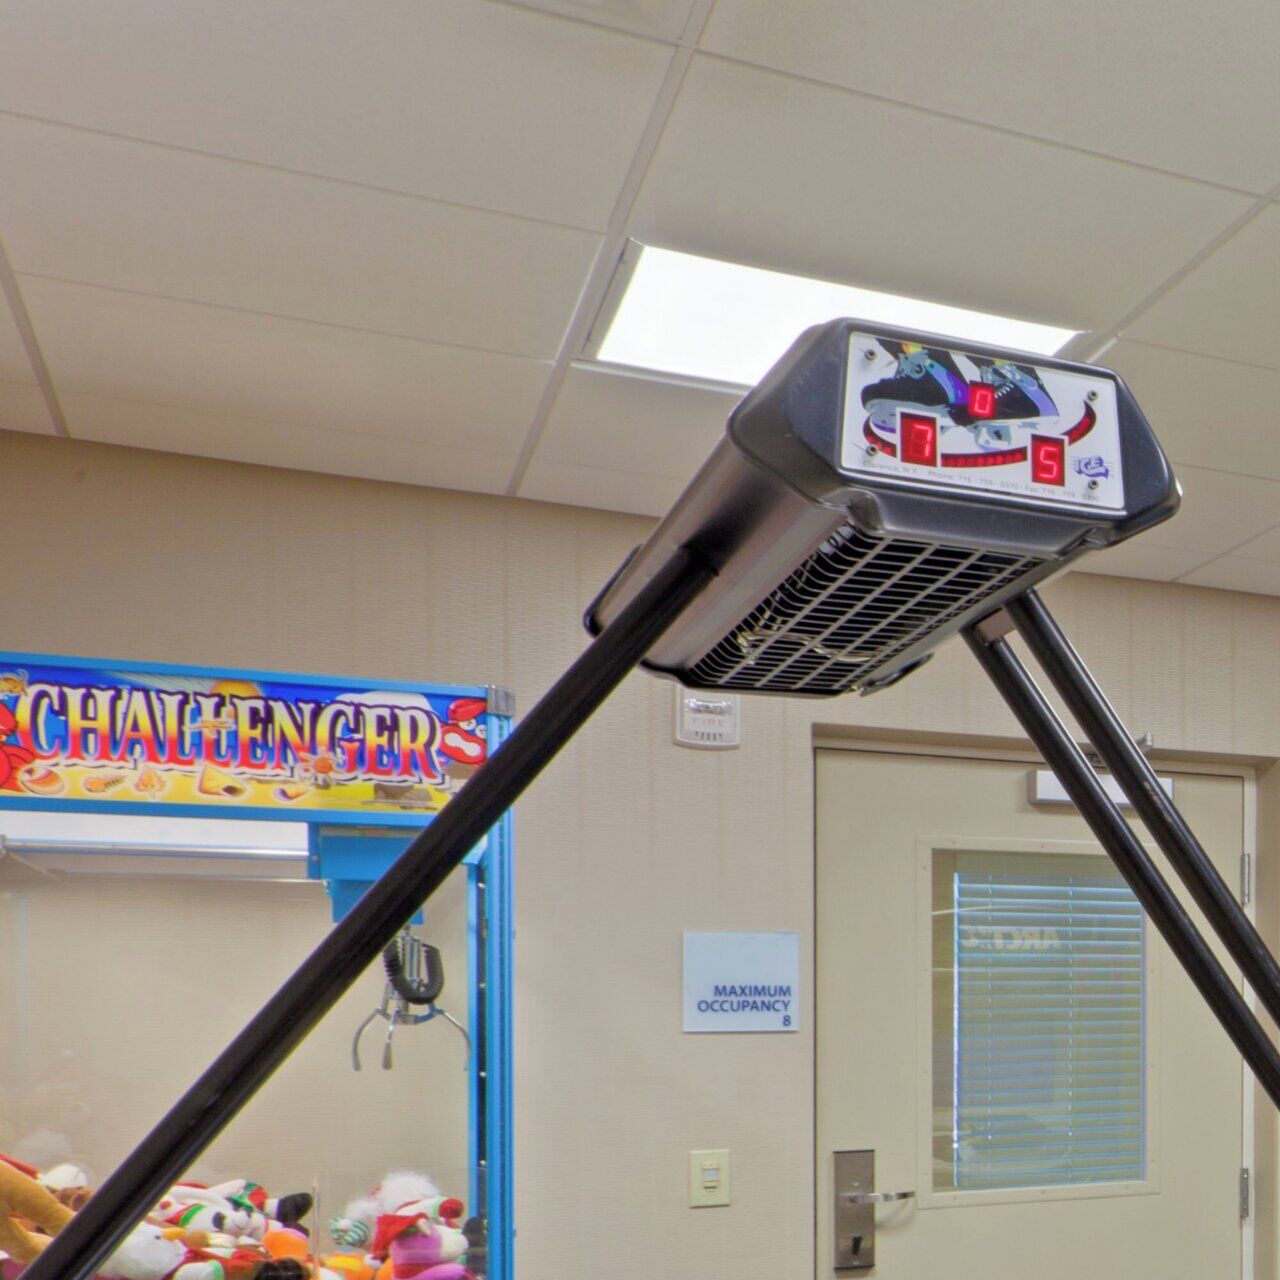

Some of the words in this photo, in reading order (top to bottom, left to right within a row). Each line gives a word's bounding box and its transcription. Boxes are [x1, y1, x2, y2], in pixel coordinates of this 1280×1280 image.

[974, 390, 992, 414] 0
[915, 424, 933, 458] 7
[1039, 446, 1058, 479] 5
[1072, 455, 1110, 479] ICE
[16, 683, 447, 786] CHALLENGER
[713, 985, 792, 997] MAXIMUM
[697, 1000, 791, 1012] OCCUPANCY
[782, 1015, 792, 1027] 8
